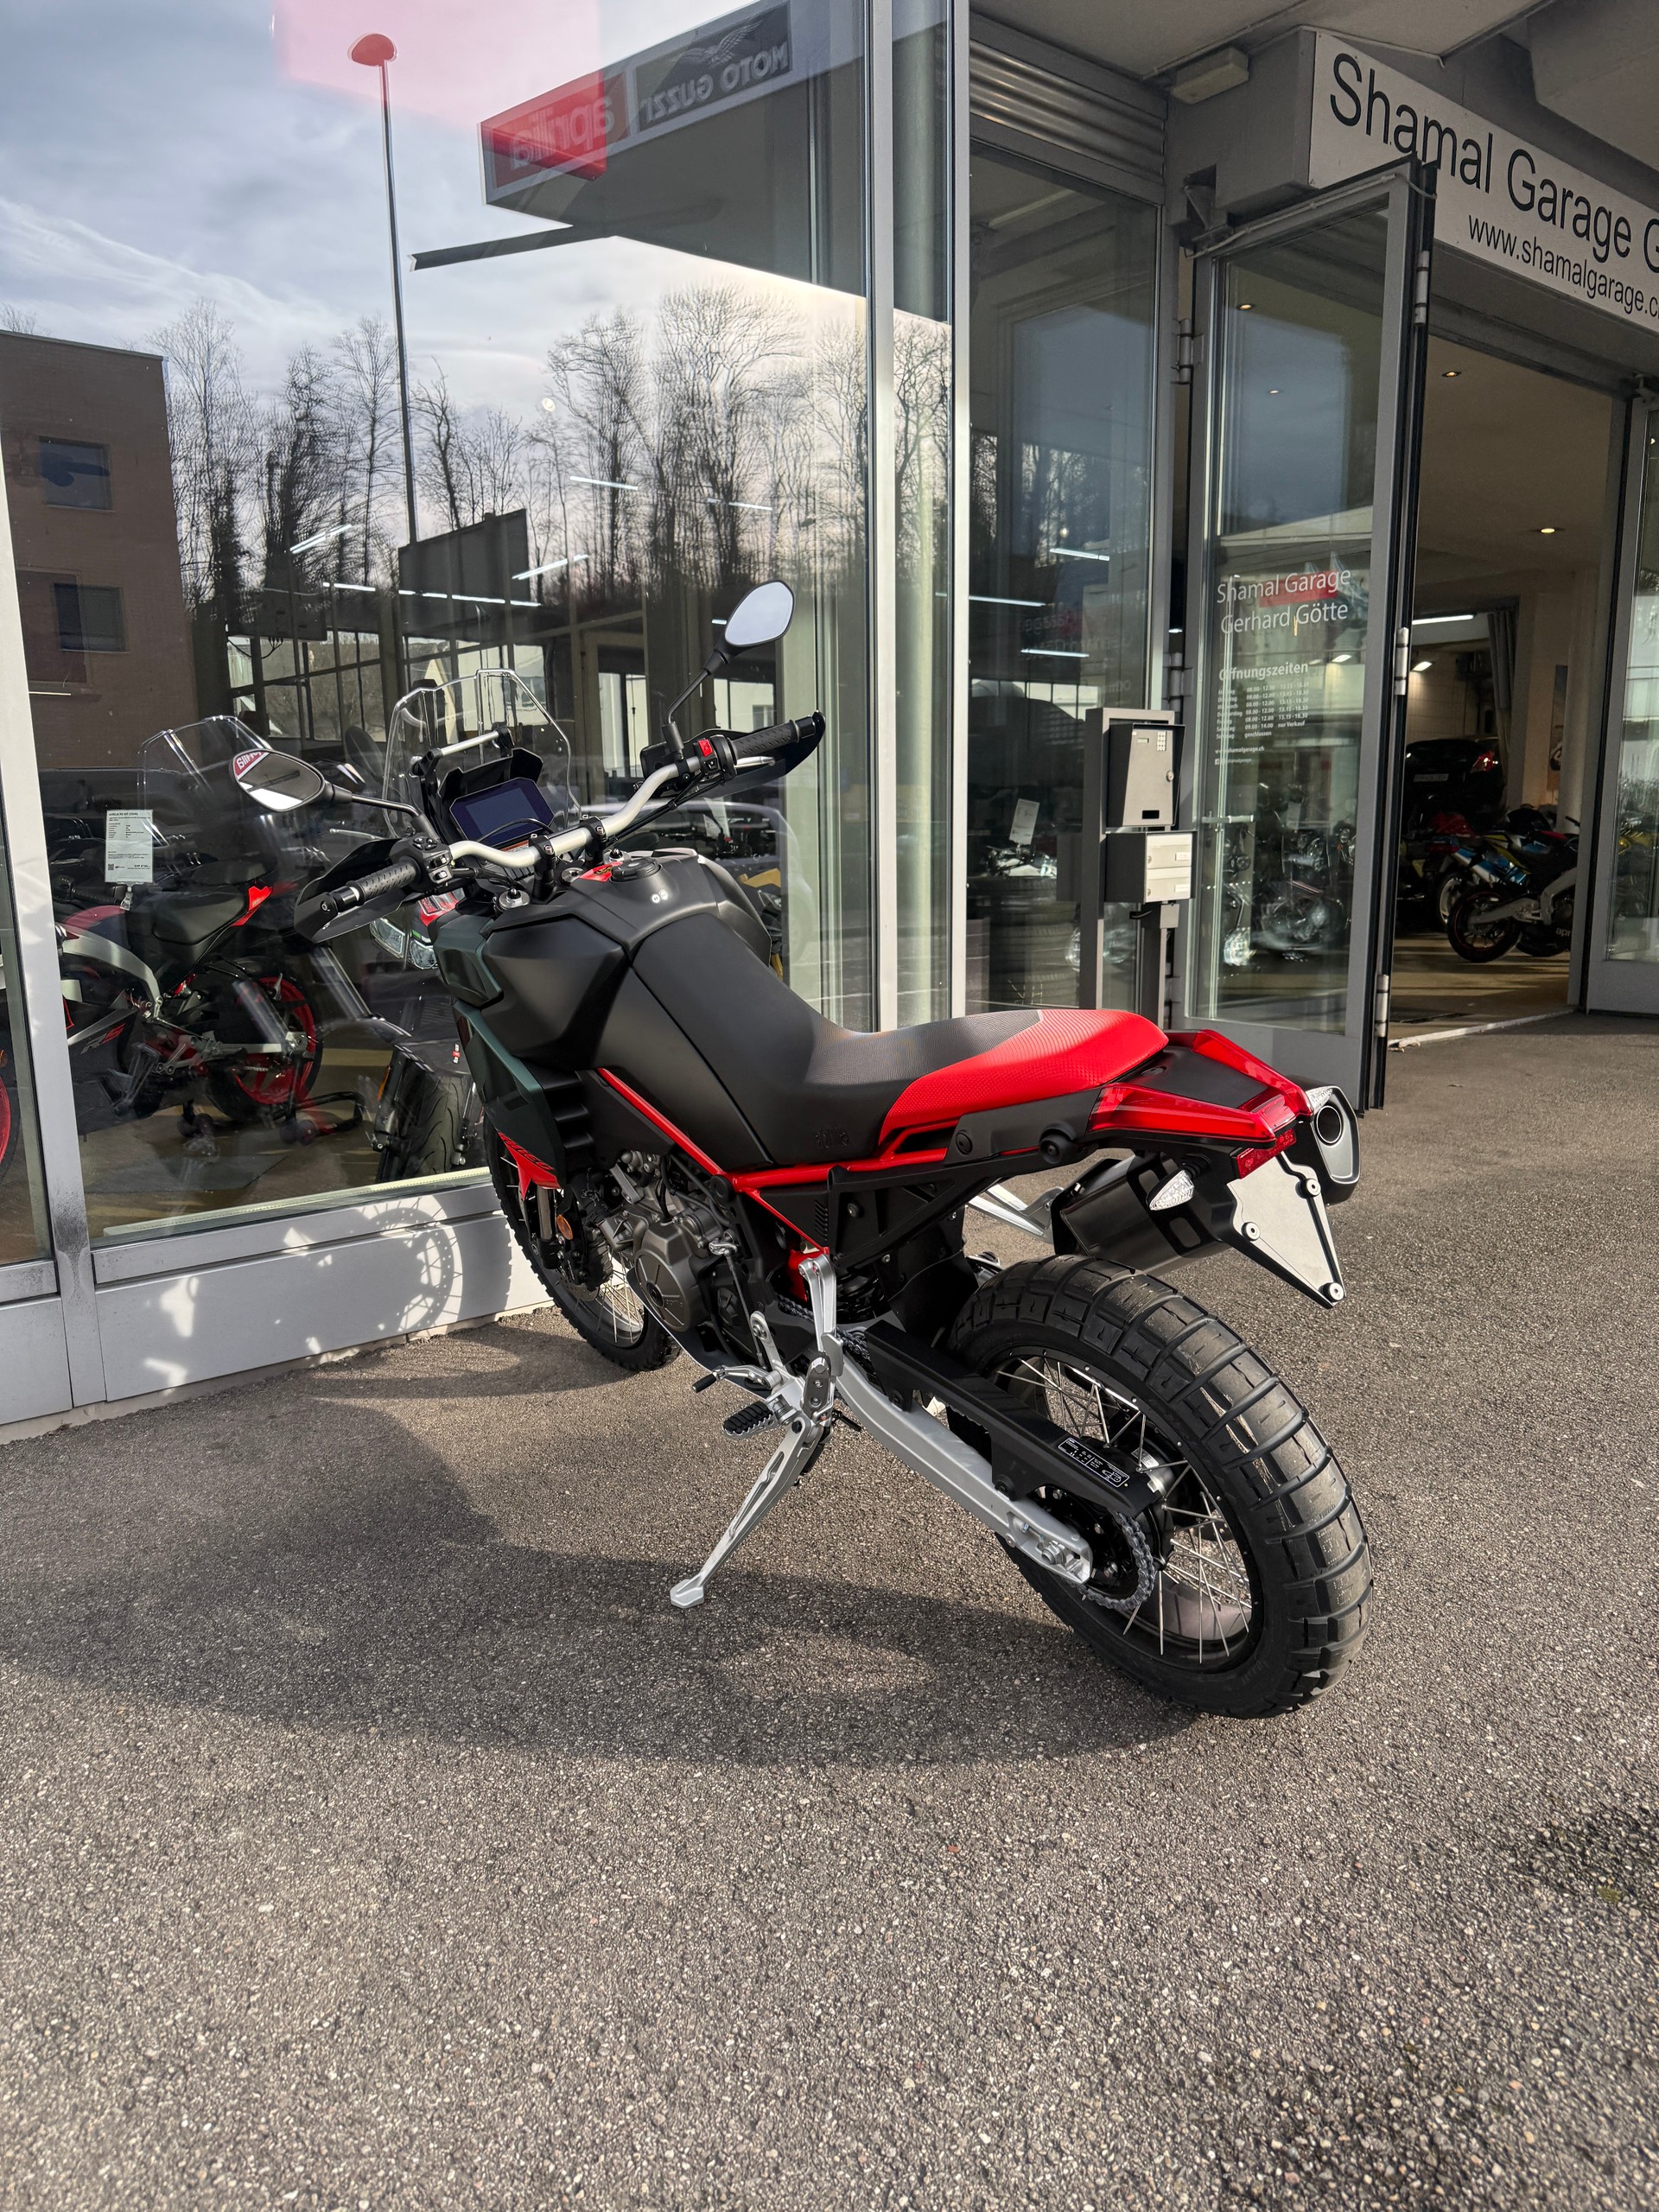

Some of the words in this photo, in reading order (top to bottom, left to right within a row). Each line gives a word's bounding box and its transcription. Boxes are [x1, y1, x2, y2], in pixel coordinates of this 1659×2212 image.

[1330, 53, 1494, 194] Shamal
[1508, 149, 1631, 264] Garage
[1468, 213, 1659, 320] www.shamalgarage.c
[1217, 575, 1280, 603] Shamal
[1285, 569, 1351, 594] Garage
[1221, 606, 1290, 634] Gerhard
[1296, 604, 1348, 625] Götte
